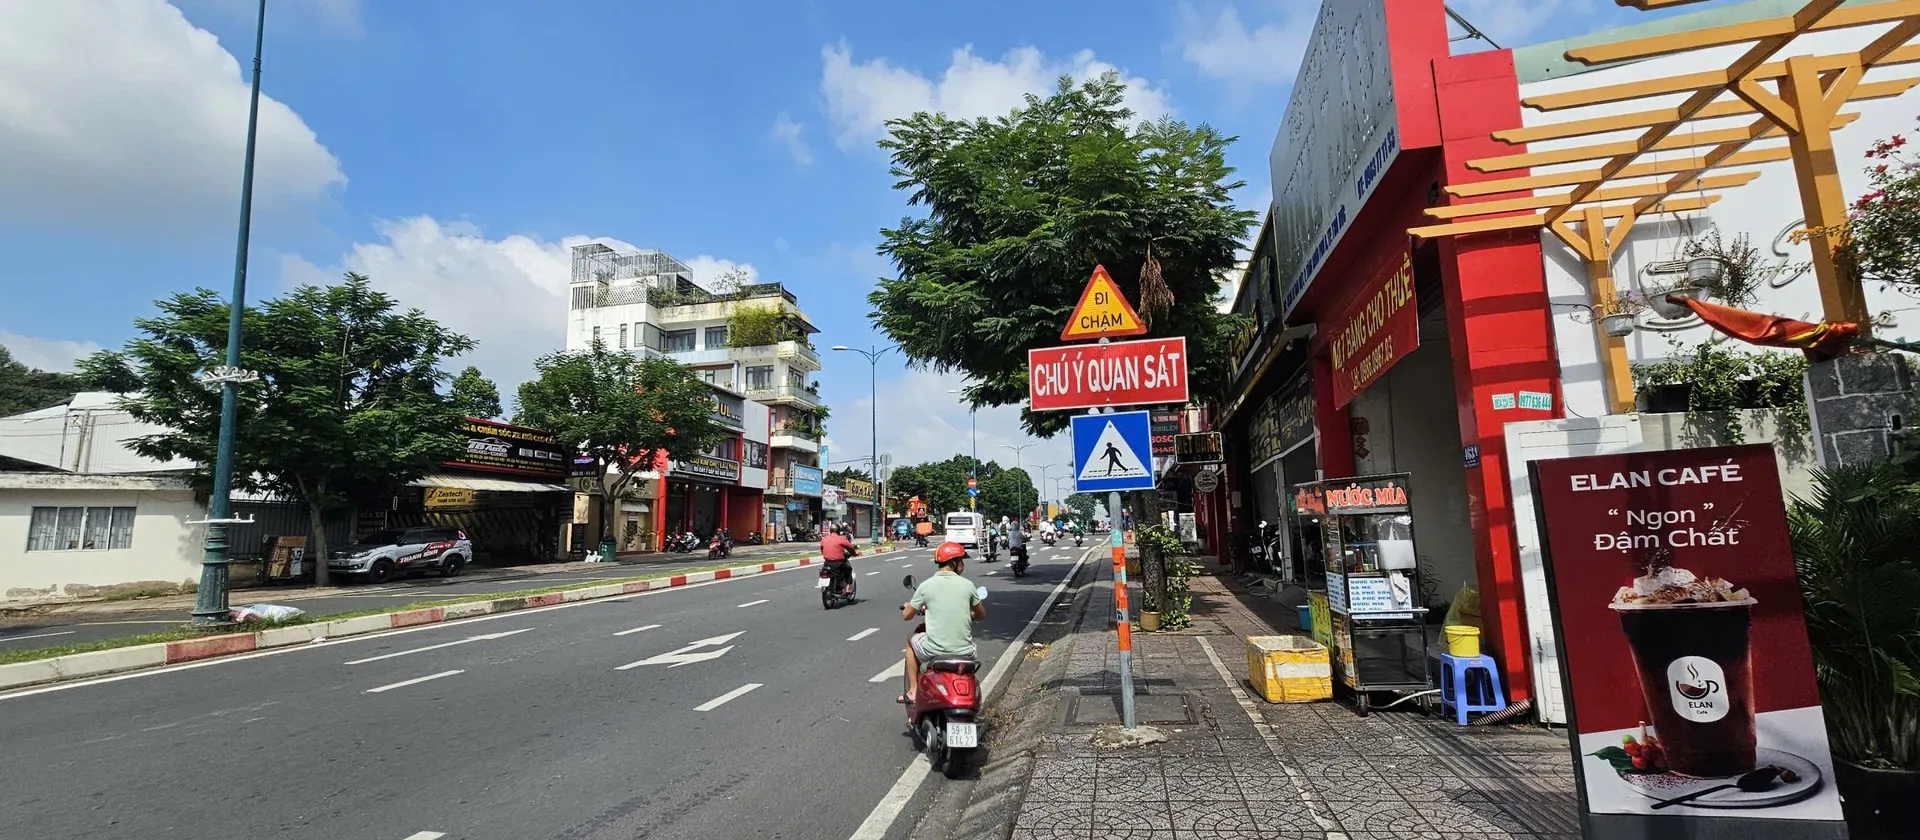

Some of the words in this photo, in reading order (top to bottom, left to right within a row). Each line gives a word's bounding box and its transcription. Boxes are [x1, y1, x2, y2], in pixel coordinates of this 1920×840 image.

[1095, 292, 1108, 305] ĐI
[1366, 290, 1384, 338] CHO
[1384, 251, 1413, 319] THUÊ
[1081, 311, 1123, 332] CHẬM
[1034, 353, 1069, 396] CHÚ
[1072, 352, 1084, 394] Ý
[1088, 356, 1139, 393] QUAN
[1144, 345, 1180, 389] SÁT
[1570, 470, 1651, 492] ELAN
[1658, 458, 1743, 486] CAFÉ
[1326, 482, 1373, 507] NƯỚC
[1375, 482, 1407, 505] MÍA
[1627, 508, 1696, 530] Ngon
[1594, 533, 1660, 554] Đậm
[1668, 520, 1740, 548] Chất
[1688, 700, 1714, 710] ELAN
